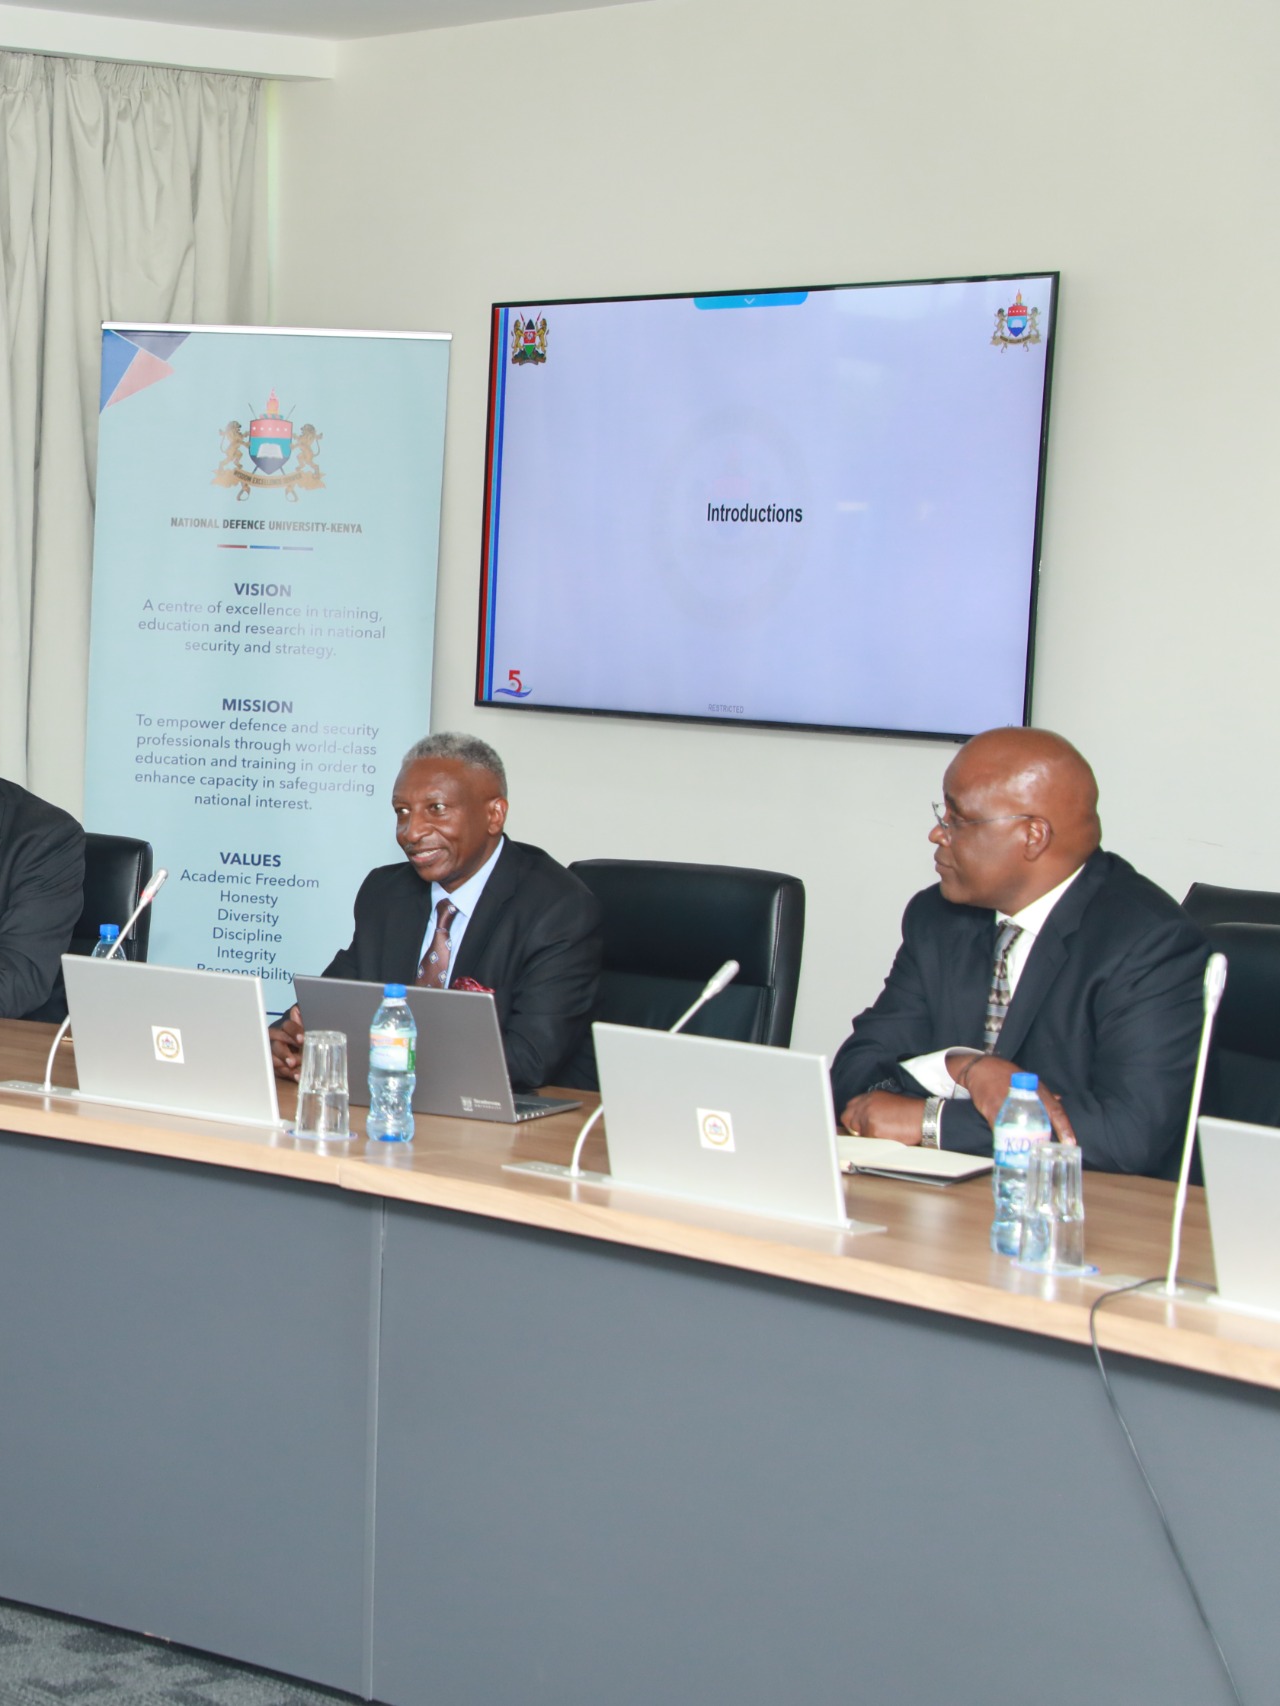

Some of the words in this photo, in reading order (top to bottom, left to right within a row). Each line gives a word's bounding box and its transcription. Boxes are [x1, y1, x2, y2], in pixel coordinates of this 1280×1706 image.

[707, 502, 803, 522] Introductions
[170, 517, 220, 528] NATIONAL
[222, 519, 265, 530] DEFENCE
[268, 521, 362, 534] UNIVERSITY-KENYA
[234, 583, 292, 597] VISION
[143, 599, 154, 611] A
[157, 601, 203, 614] centre
[207, 601, 223, 615] of
[225, 602, 301, 617] excellence
[306, 604, 318, 618] in
[322, 606, 384, 624] training,
[138, 618, 210, 633] education
[213, 621, 241, 634] and
[245, 621, 305, 636] research
[310, 623, 323, 637] in
[327, 625, 386, 639] national
[185, 639, 240, 656] security
[243, 641, 270, 654] and
[275, 642, 337, 659] strategy.
[221, 698, 293, 714] MISSION
[708, 704, 744, 713] RESTRICTED
[136, 714, 153, 727] To
[157, 718, 226, 735] empower
[229, 717, 287, 733] defence
[291, 720, 318, 734] and
[322, 723, 380, 740] security
[136, 734, 230, 750] professionals
[234, 738, 291, 754] through
[295, 741, 377, 755] world-class
[135, 752, 207, 767] education
[210, 755, 238, 768] and
[241, 757, 296, 774] training
[300, 759, 313, 771] in
[317, 760, 357, 774] order
[361, 762, 376, 775] to
[134, 771, 196, 785] enhance
[199, 774, 258, 790] capacity
[262, 776, 275, 788] in
[279, 777, 375, 796] safeguarding
[194, 794, 251, 807] national
[255, 796, 312, 810] interest.
[220, 852, 282, 867] VALUES
[180, 869, 251, 885] Academic
[255, 873, 320, 888] Freedom
[220, 890, 278, 907] Honesty
[217, 908, 279, 926] Diversity
[212, 926, 282, 944] Discipline
[217, 946, 276, 963] Integrity
